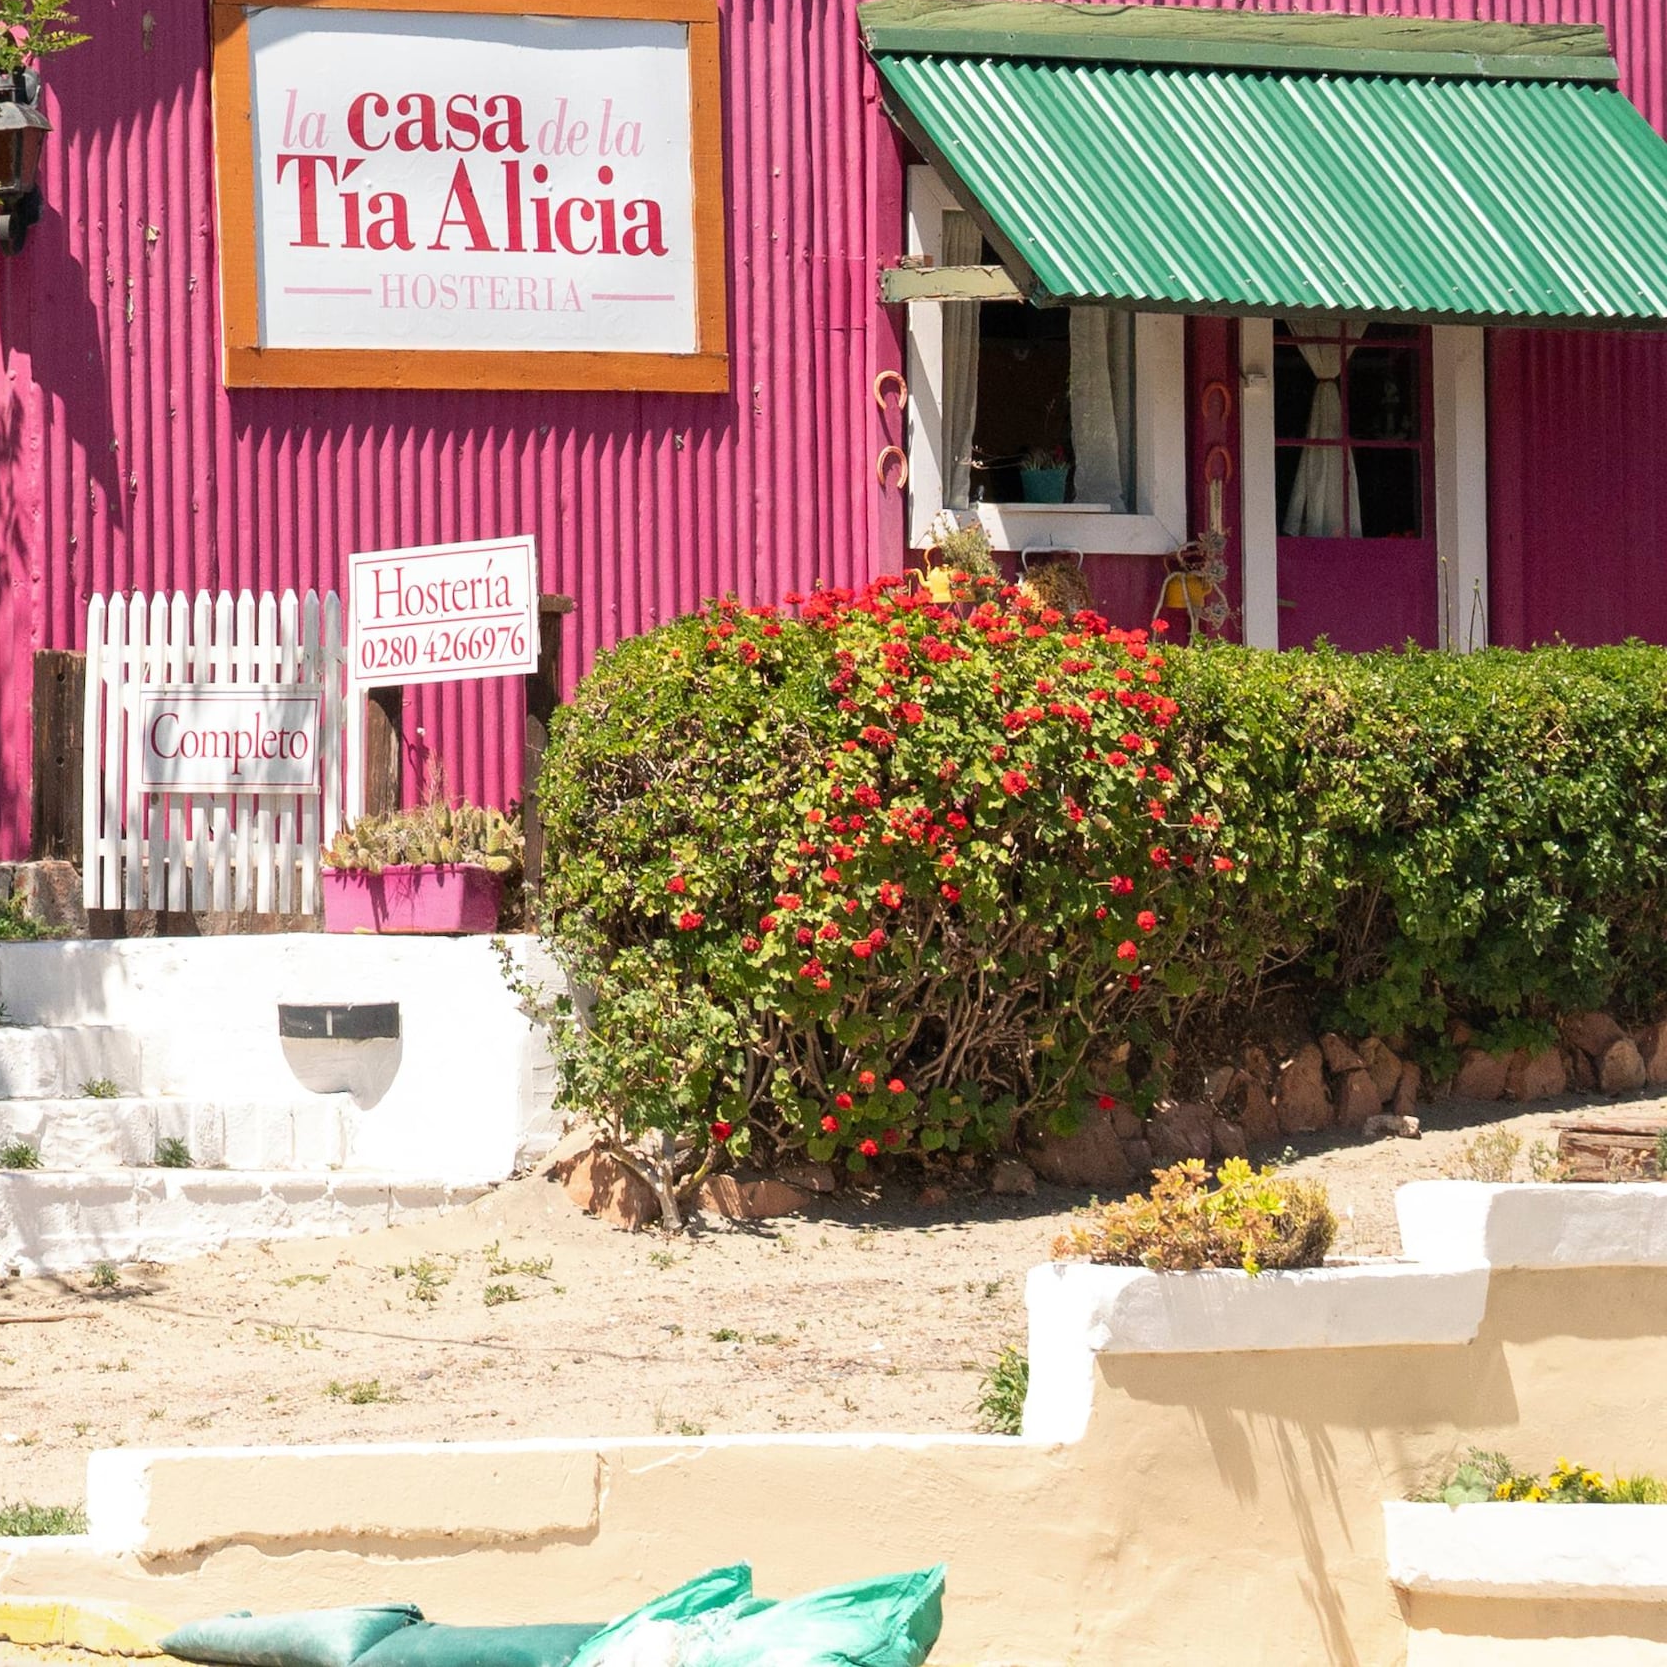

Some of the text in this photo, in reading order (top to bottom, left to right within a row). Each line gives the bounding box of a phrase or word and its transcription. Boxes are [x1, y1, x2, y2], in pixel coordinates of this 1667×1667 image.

[282, 89, 645, 157] la casa de la
[276, 154, 669, 257] Tía Alicia
[378, 273, 585, 313] HOSTERIA
[371, 558, 512, 620] Hostería
[361, 623, 525, 670] 0280 4266976
[150, 712, 308, 775] Completo
